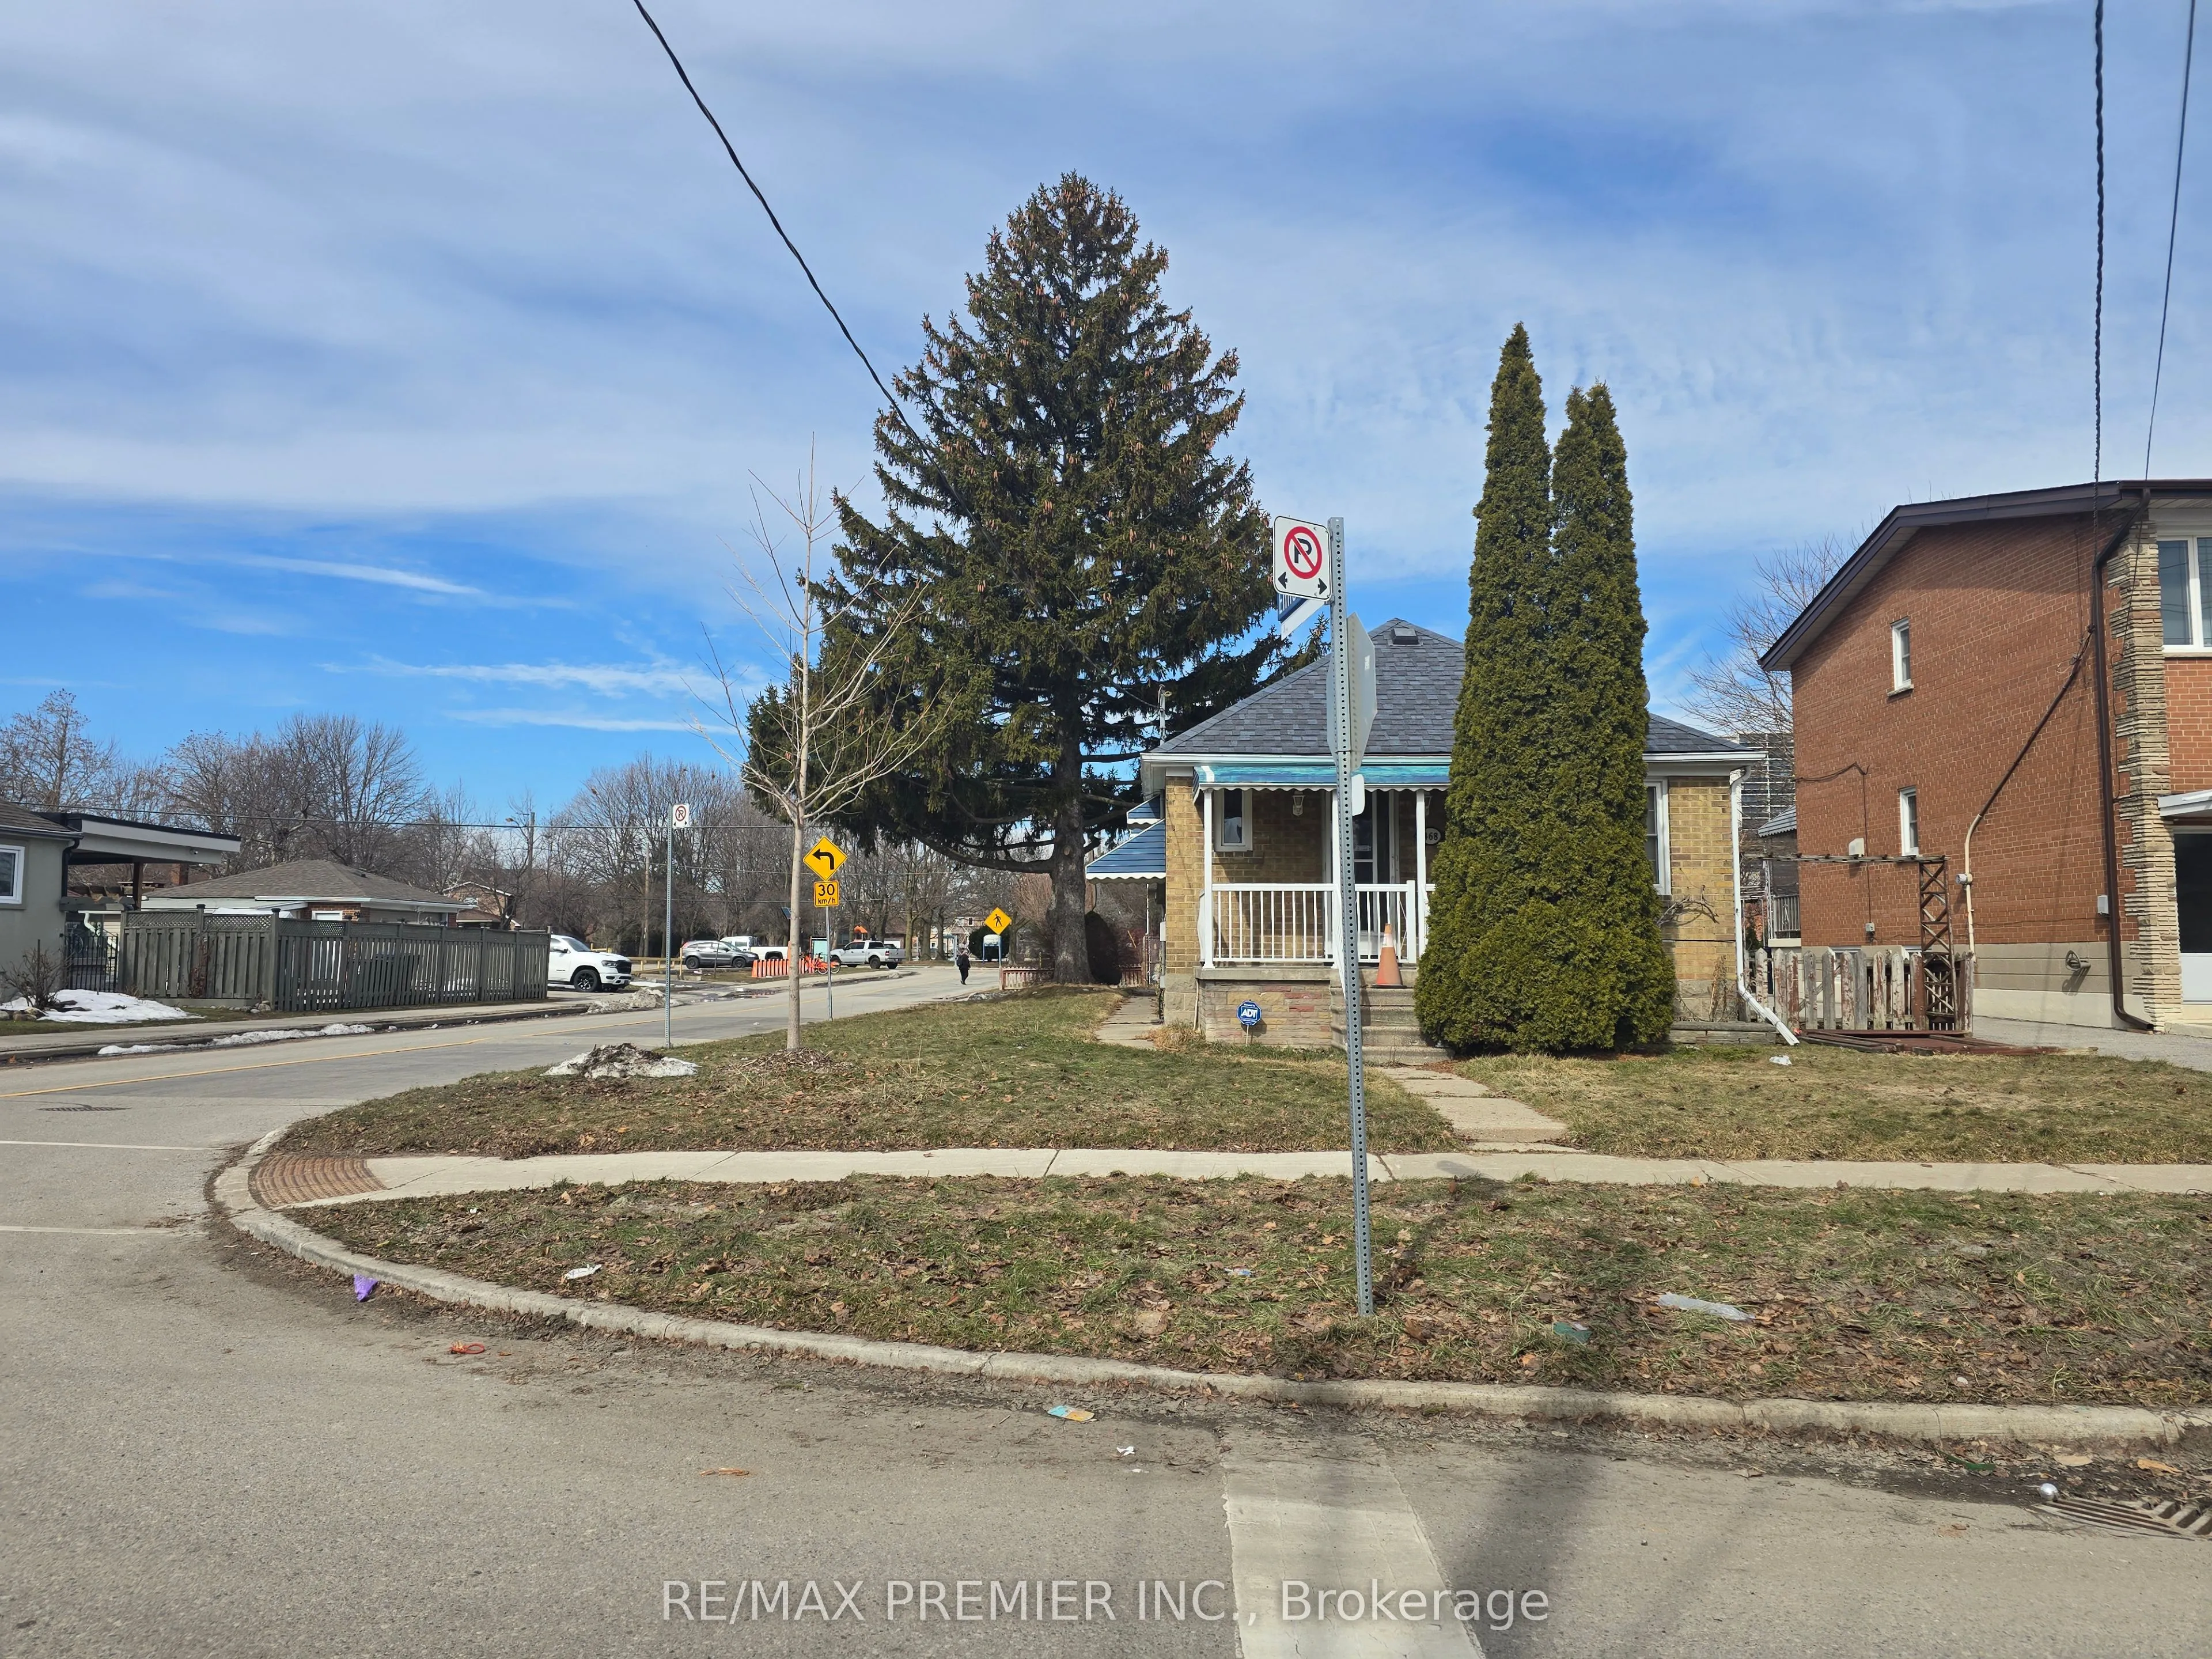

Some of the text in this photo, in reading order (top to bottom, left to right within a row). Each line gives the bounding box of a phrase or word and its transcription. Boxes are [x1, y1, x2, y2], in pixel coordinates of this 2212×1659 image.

[1294, 537, 1312, 563] P
[1425, 832, 1438, 840] 68
[818, 884, 835, 896] 30
[1241, 1008, 1257, 1018] ADT
